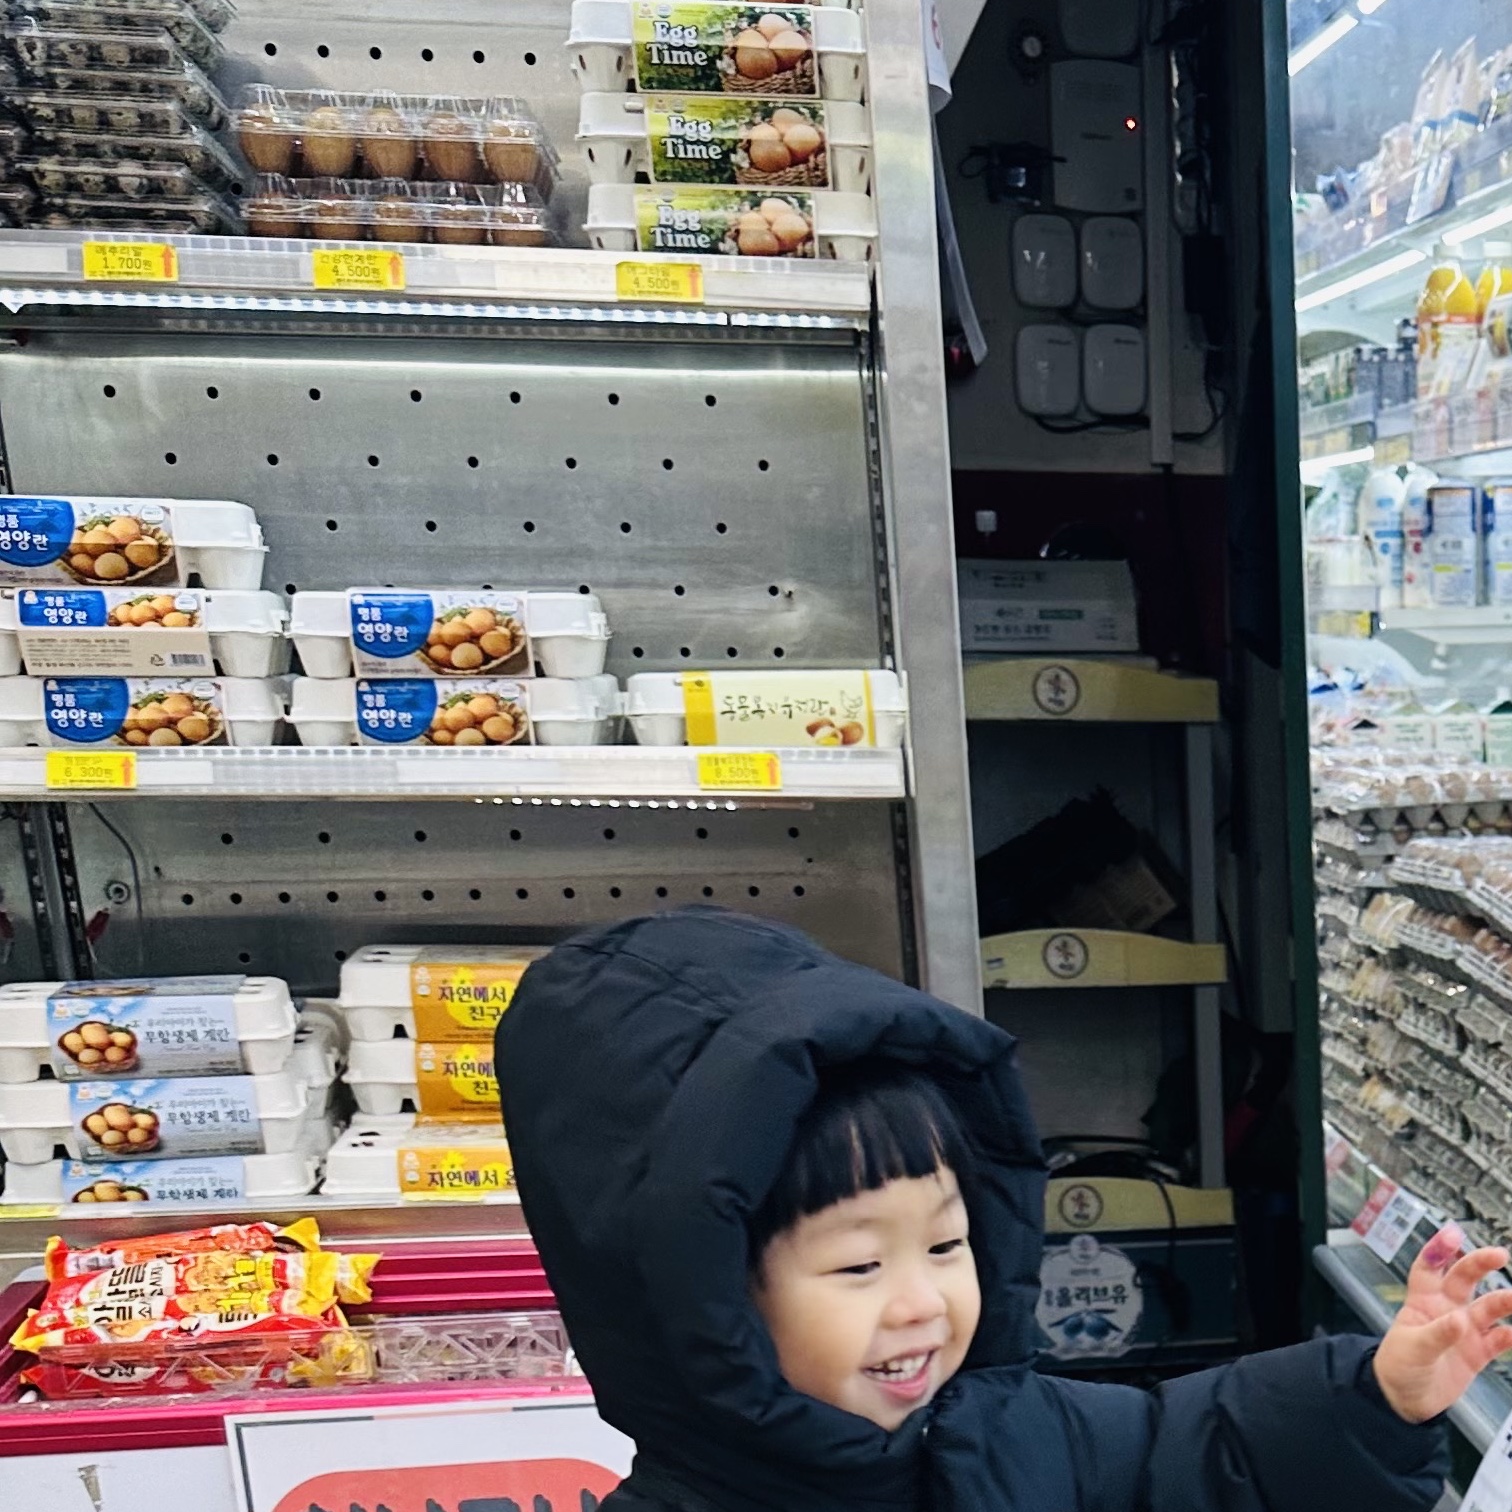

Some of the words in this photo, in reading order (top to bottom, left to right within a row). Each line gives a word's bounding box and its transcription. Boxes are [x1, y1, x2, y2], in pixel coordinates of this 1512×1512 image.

[653, 21, 698, 48] Egg
[646, 44, 708, 66] Time
[668, 115, 713, 142] Egg
[661, 138, 722, 160] Time
[657, 206, 701, 231] Egg
[651, 228, 711, 249] Time
[44, 609, 87, 624] 영양란
[356, 606, 383, 622] 명품
[356, 623, 409, 643] 영양란
[51, 694, 76, 706] 명품
[361, 692, 388, 707] 명품
[51, 709, 103, 728] 영양란
[361, 708, 413, 728] 영양란
[438, 986, 507, 1003] 자연에서
[427, 1170, 499, 1188] 자연에서
